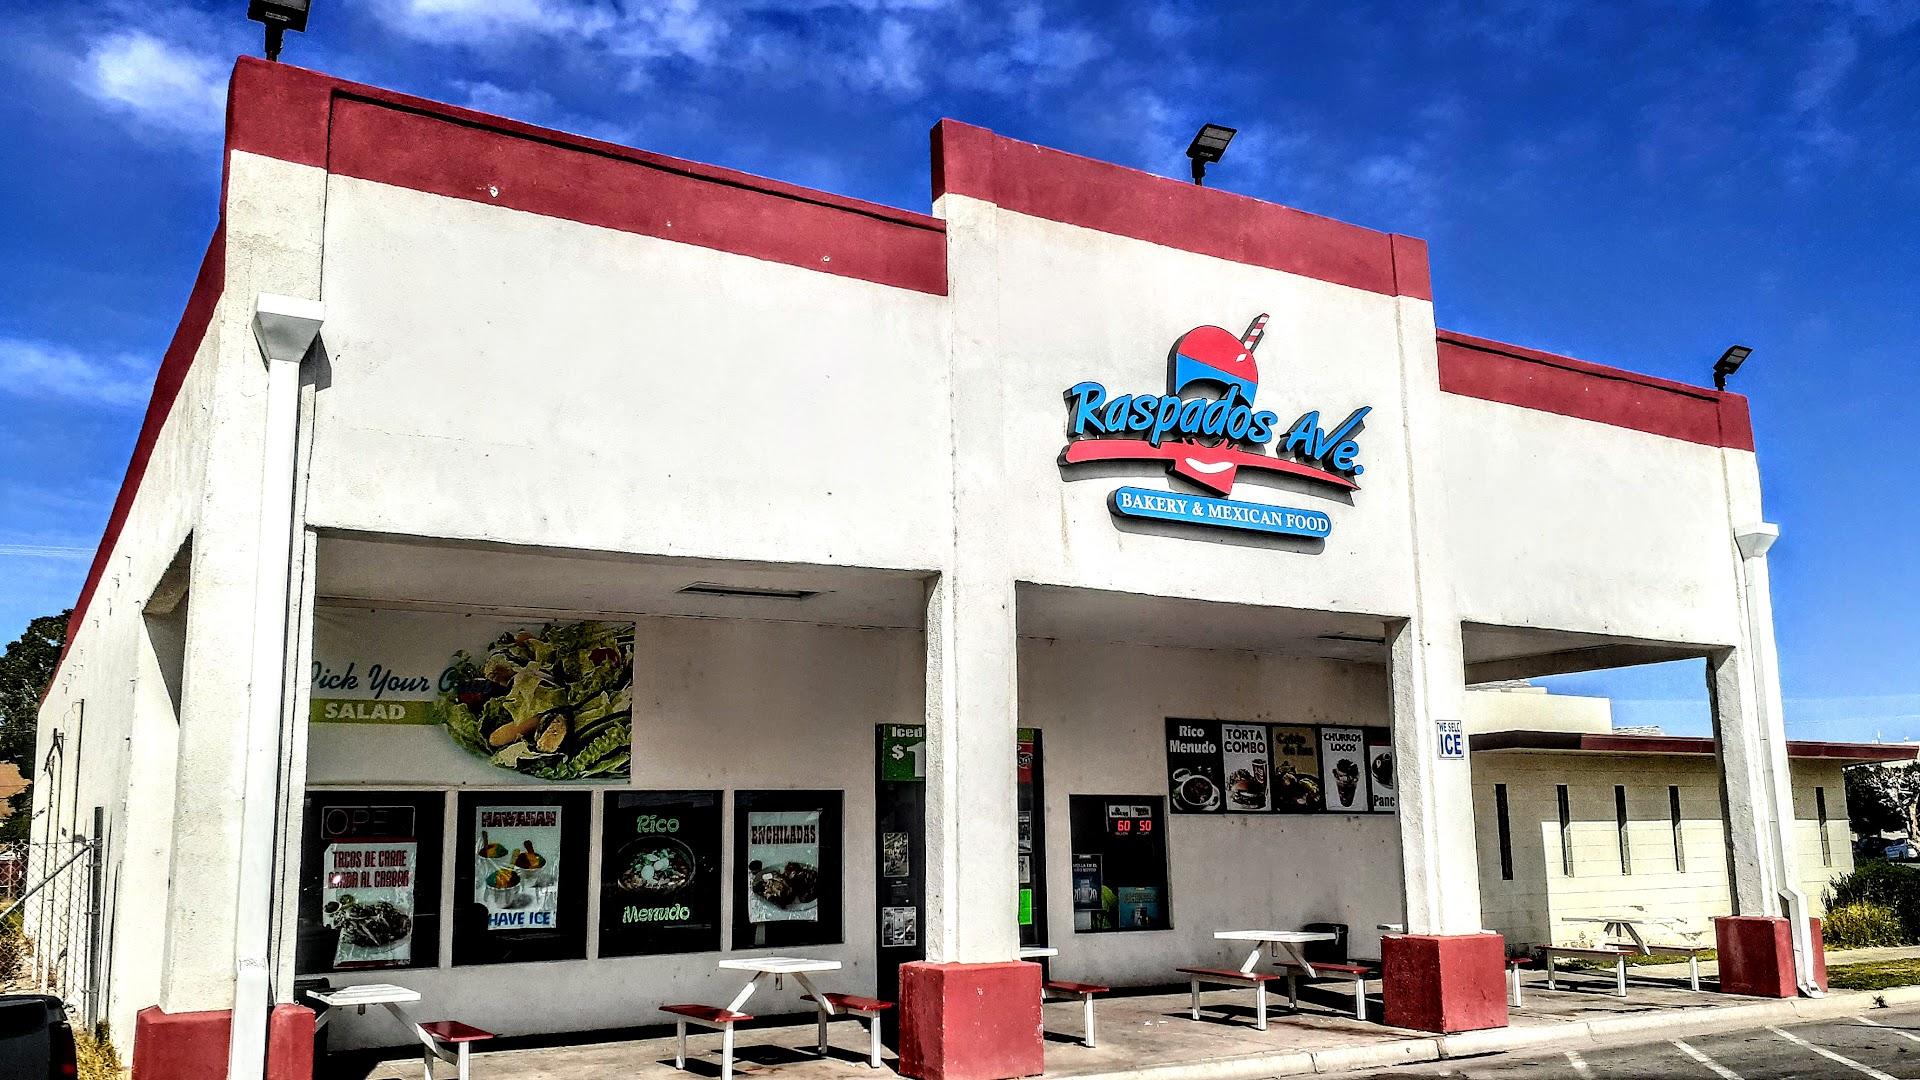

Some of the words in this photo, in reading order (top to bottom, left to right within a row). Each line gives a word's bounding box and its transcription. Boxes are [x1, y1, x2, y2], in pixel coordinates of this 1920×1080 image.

[1071, 381, 1278, 445] Raspados
[1287, 406, 1372, 475] Ave.
[1120, 492, 1188, 515] BAKERY
[1192, 503, 1204, 517] &
[1207, 505, 1283, 526] MEXICAN
[1286, 514, 1328, 533] FOOD
[368, 664, 430, 699] Your
[325, 703, 406, 720] SALAD
[892, 726, 922, 738] Iced
[1179, 725, 1205, 737] Rico
[1437, 722, 1447, 732] WE
[1225, 729, 1263, 740] TORTA
[1323, 733, 1362, 742] CHURROS
[1169, 740, 1216, 753] Menudo
[1224, 741, 1266, 753] COMBO
[1330, 743, 1357, 752] LOCOS
[1440, 734, 1462, 755] ICE
[636, 815, 679, 833] Rico
[1118, 820, 1130, 831] 60
[1140, 820, 1151, 831] 50
[751, 825, 816, 845] ENCHILADAS
[332, 851, 362, 868] TACOS
[364, 851, 376, 867] DE
[361, 871, 371, 888] AL
[488, 912, 525, 926] HAVE
[529, 912, 550, 924] ICE
[623, 903, 690, 923] Menudo
